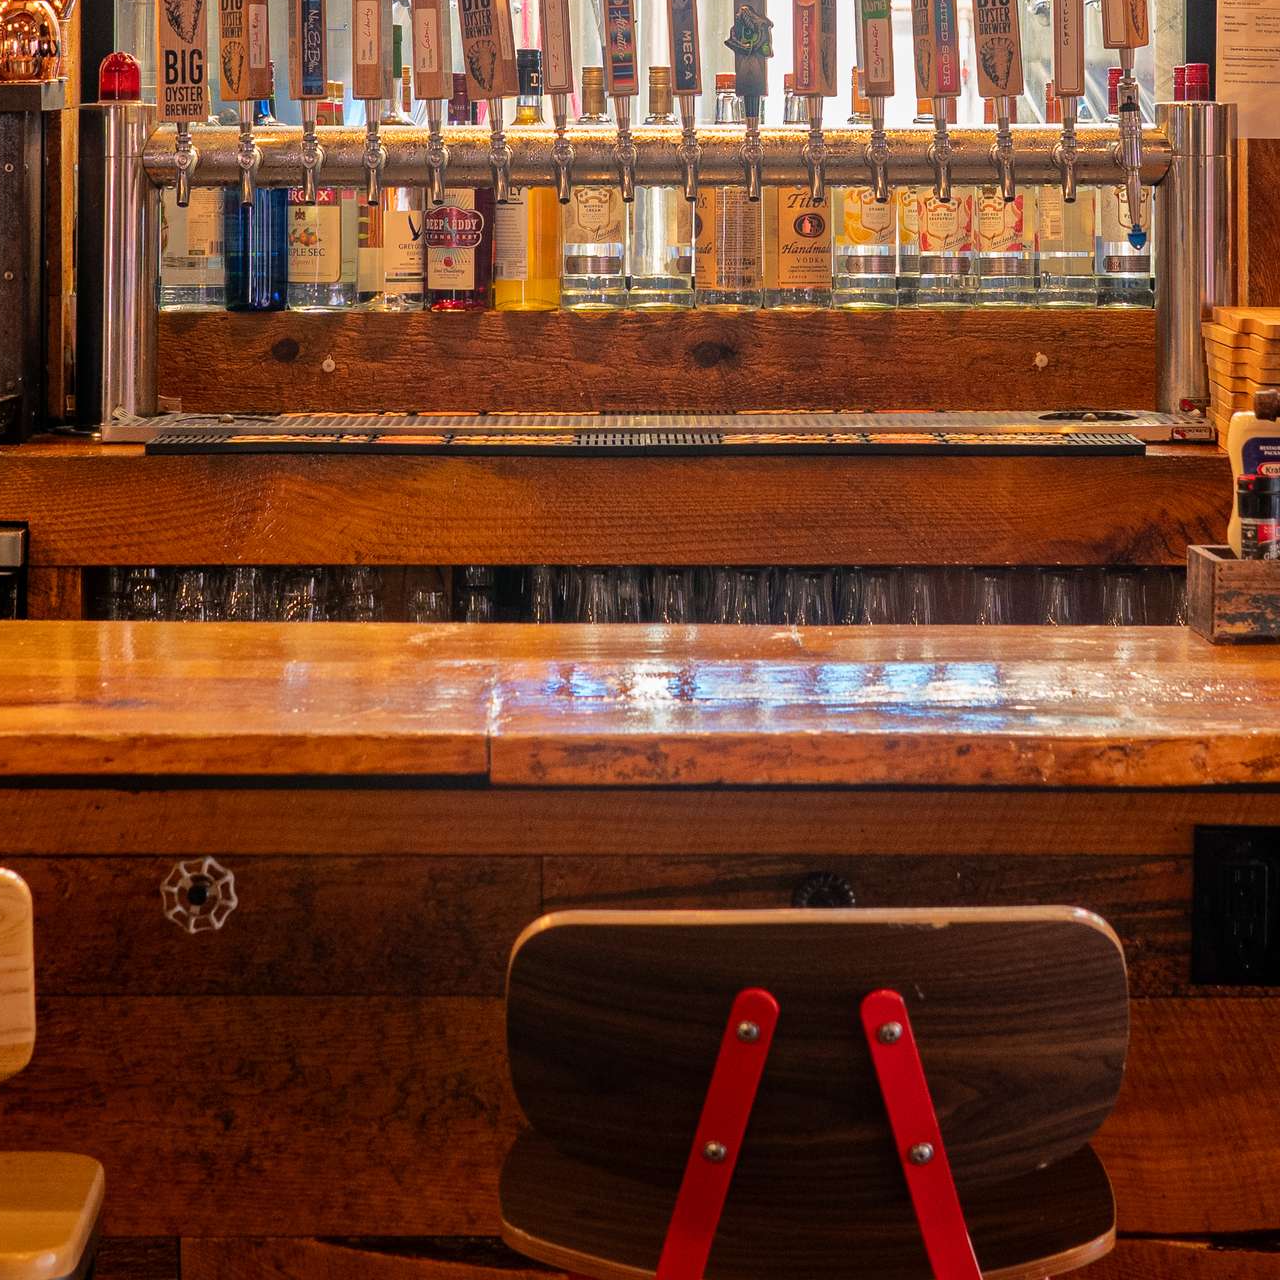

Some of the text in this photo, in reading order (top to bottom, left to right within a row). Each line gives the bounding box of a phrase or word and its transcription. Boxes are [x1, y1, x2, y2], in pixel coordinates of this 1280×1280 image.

[222, 12, 242, 27] OYSTER
[464, 10, 492, 26] OYSTER
[978, 8, 1010, 23] OYSTER
[222, 26, 242, 38] BREWERY
[465, 26, 492, 39] BREWERY
[979, 22, 1011, 36] BREWERY
[682, 30, 694, 80] MEG-A
[164, 49, 203, 84] BIG
[939, 44, 951, 87] SOUR
[165, 86, 202, 102] OYSTER
[165, 104, 202, 116] BREWERY
[426, 219, 477, 230] DEEP EDDY
[308, 248, 325, 256] SEC
